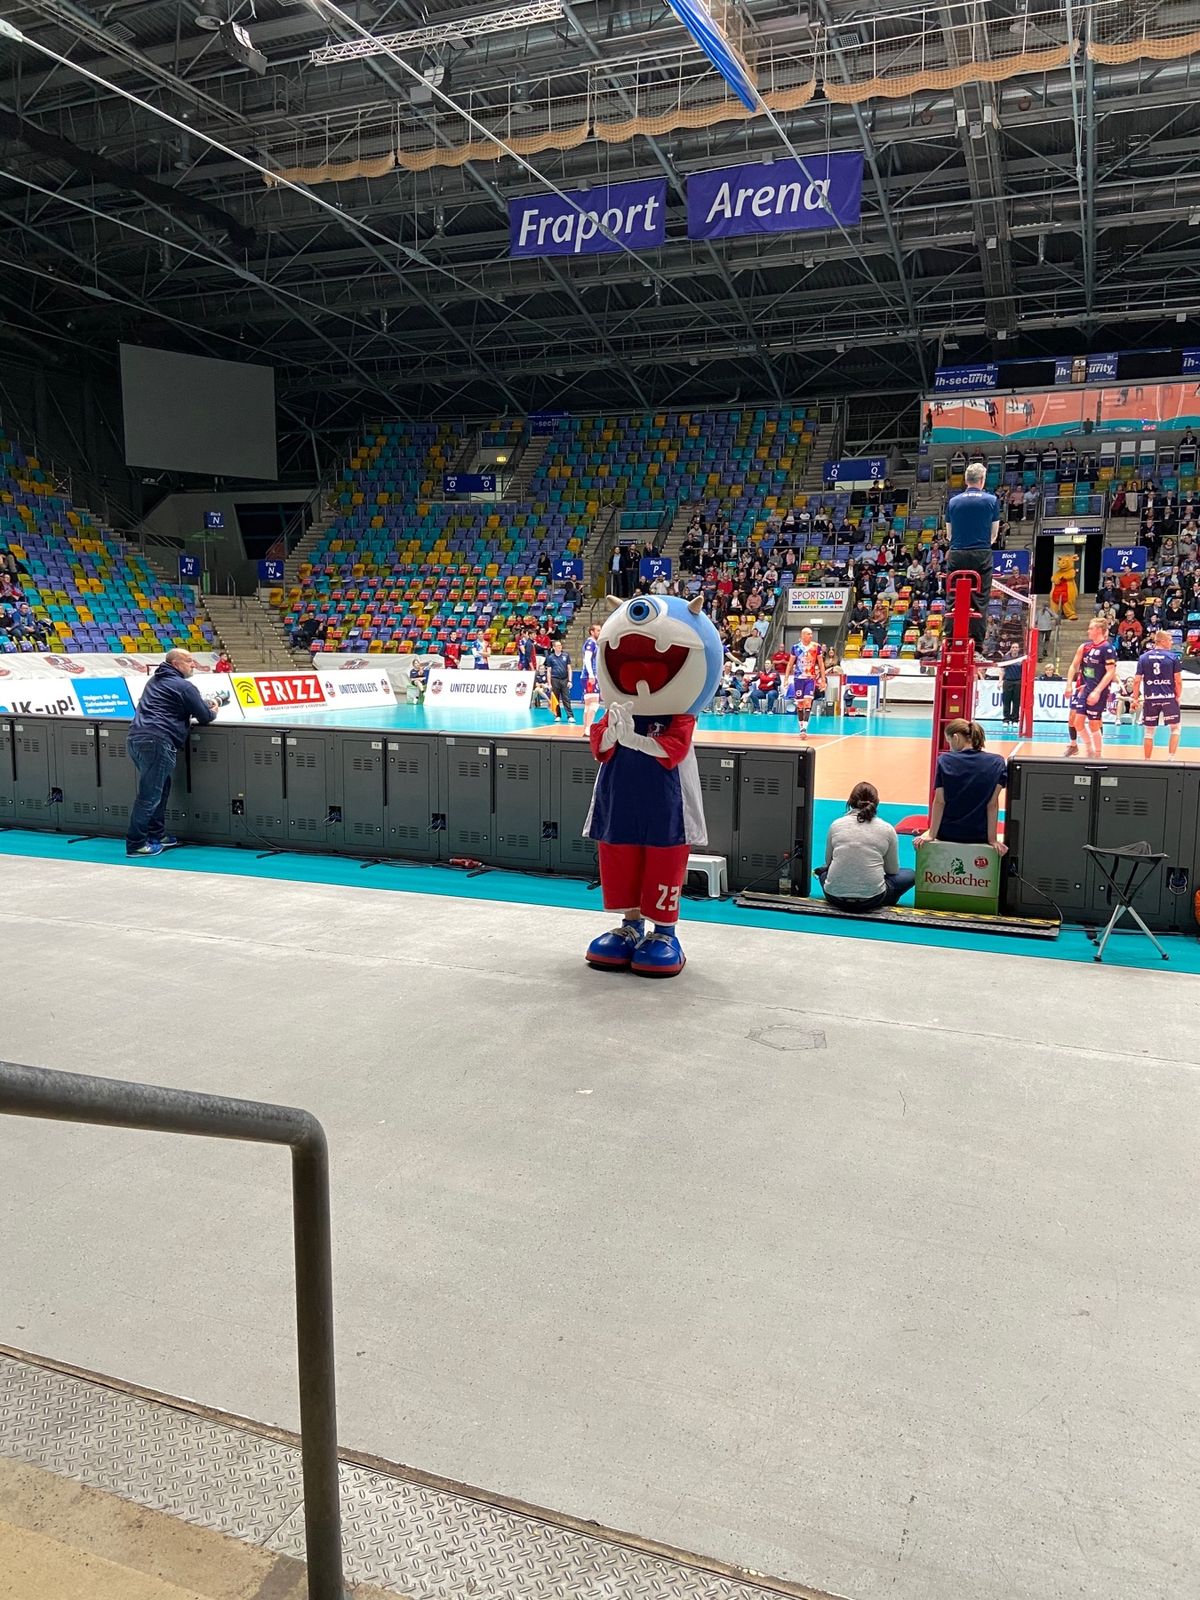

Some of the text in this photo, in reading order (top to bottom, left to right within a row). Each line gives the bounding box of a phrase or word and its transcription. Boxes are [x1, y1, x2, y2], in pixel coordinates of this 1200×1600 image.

[518, 178, 832, 253] Fraport Arena
[831, 469, 838, 477] Q
[871, 466, 878, 476] Q
[212, 516, 220, 524] N
[1005, 559, 1013, 568] R
[1121, 556, 1129, 565] R
[187, 563, 193, 571] N
[267, 567, 275, 575] N
[565, 566, 572, 574] P
[792, 590, 845, 600] SPORTSTADT
[1153, 662, 1161, 675] 3
[258, 678, 321, 702] FRIZZ
[338, 682, 378, 695] UNITED VOLLEYS
[449, 683, 508, 694] UNITED VOLLEYS
[924, 871, 992, 888] Rosbacher
[655, 883, 680, 912] 23
